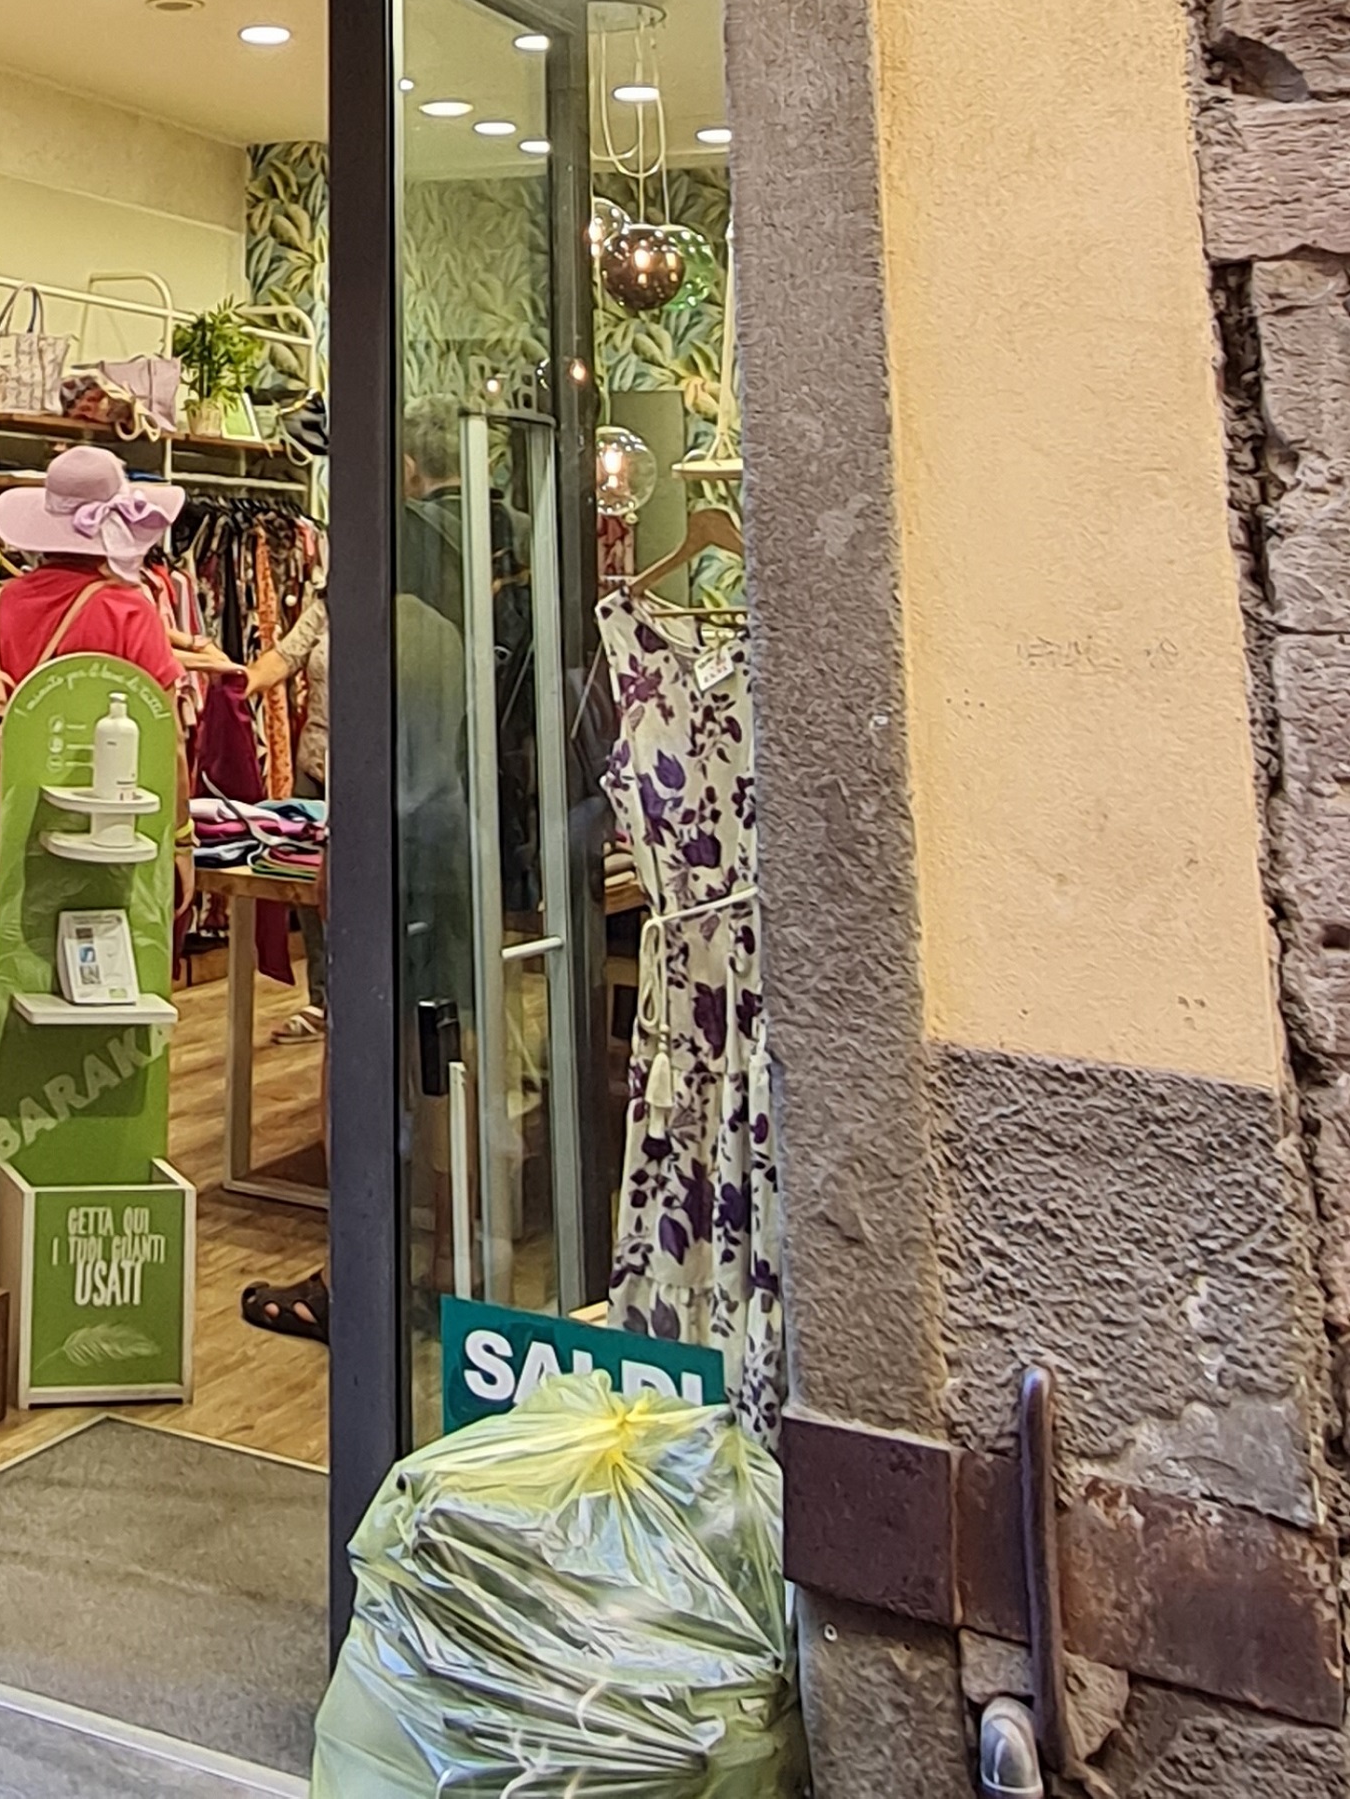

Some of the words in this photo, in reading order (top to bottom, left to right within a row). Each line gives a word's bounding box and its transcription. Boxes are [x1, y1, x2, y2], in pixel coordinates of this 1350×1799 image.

[68, 1206, 114, 1235] GETTA
[123, 1206, 150, 1239] QUI
[69, 1234, 103, 1264] TUOI
[111, 1234, 166, 1263] GUANTI
[75, 1259, 145, 1306] USATI
